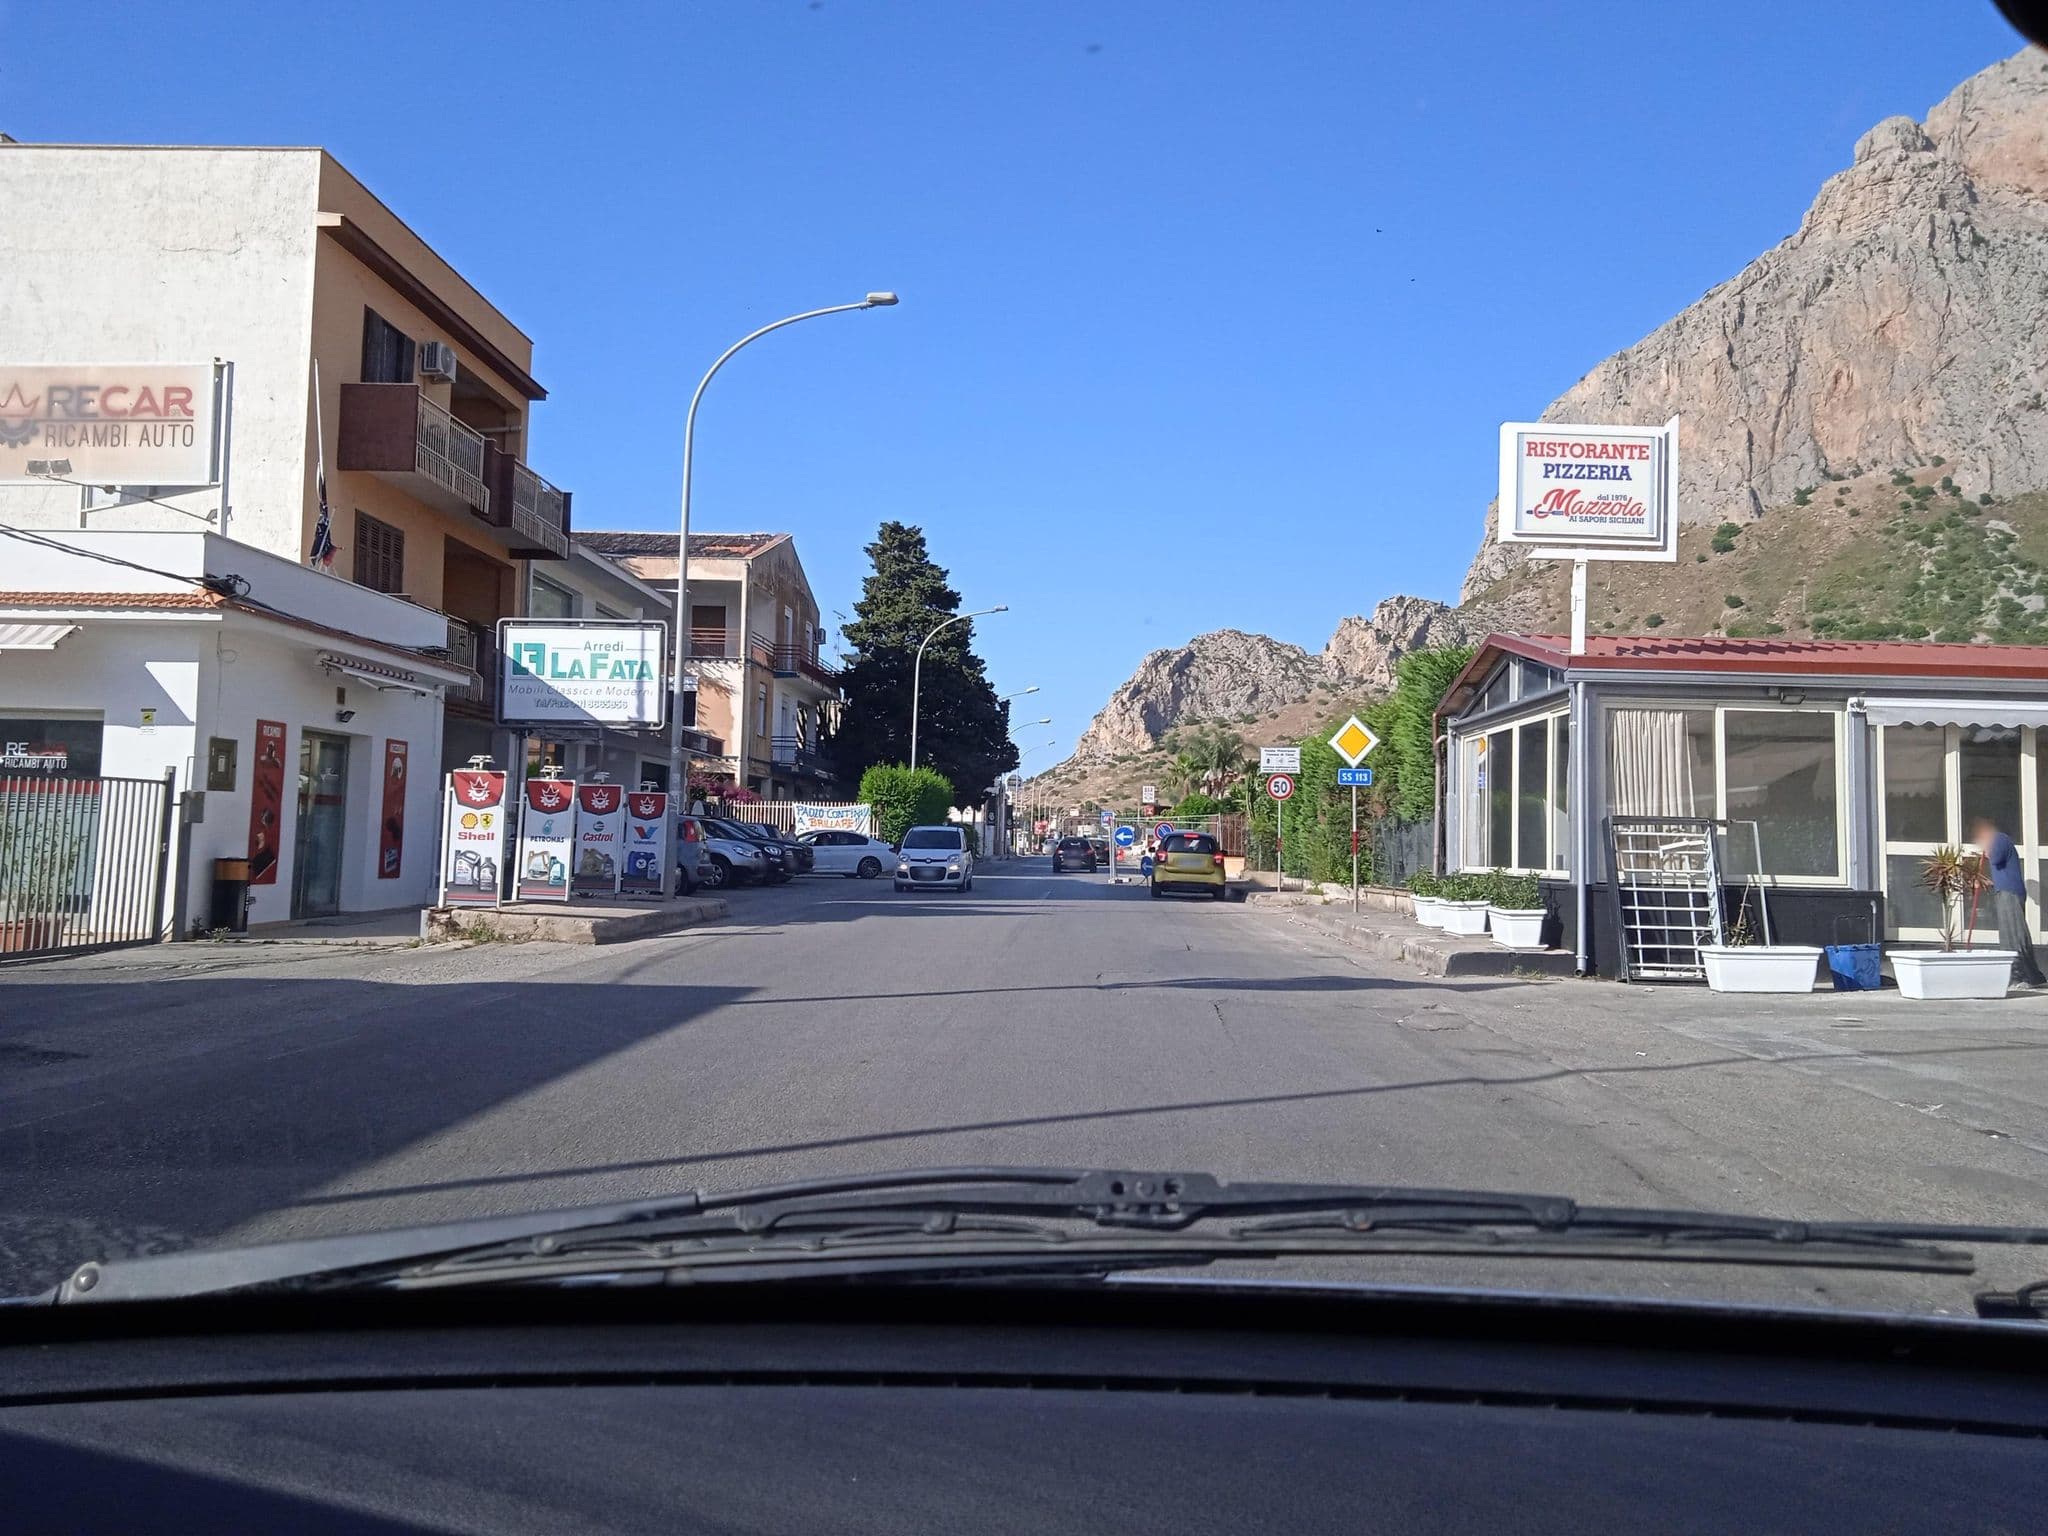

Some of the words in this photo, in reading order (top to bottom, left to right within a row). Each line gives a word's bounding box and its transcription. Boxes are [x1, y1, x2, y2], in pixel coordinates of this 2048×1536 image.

[48, 386, 194, 417] RECAR
[45, 424, 128, 447] RICAMBI
[139, 424, 194, 448] AUTO
[1526, 441, 1650, 460] RISTORANTE
[1543, 463, 1632, 481] PIZZERIA
[1534, 488, 1647, 519] Mazzola
[583, 641, 624, 651] Arredi
[508, 685, 543, 695] Mobili
[547, 685, 593, 695] Classici
[605, 686, 653, 697] Moderni
[5, 758, 40, 769] RICAMBI
[43, 758, 67, 769] AUTO
[1342, 773, 1353, 781] SS
[1355, 773, 1368, 781] 113
[1273, 781, 1288, 794] 50
[458, 832, 495, 840] Shell
[583, 832, 614, 842] Castrol
